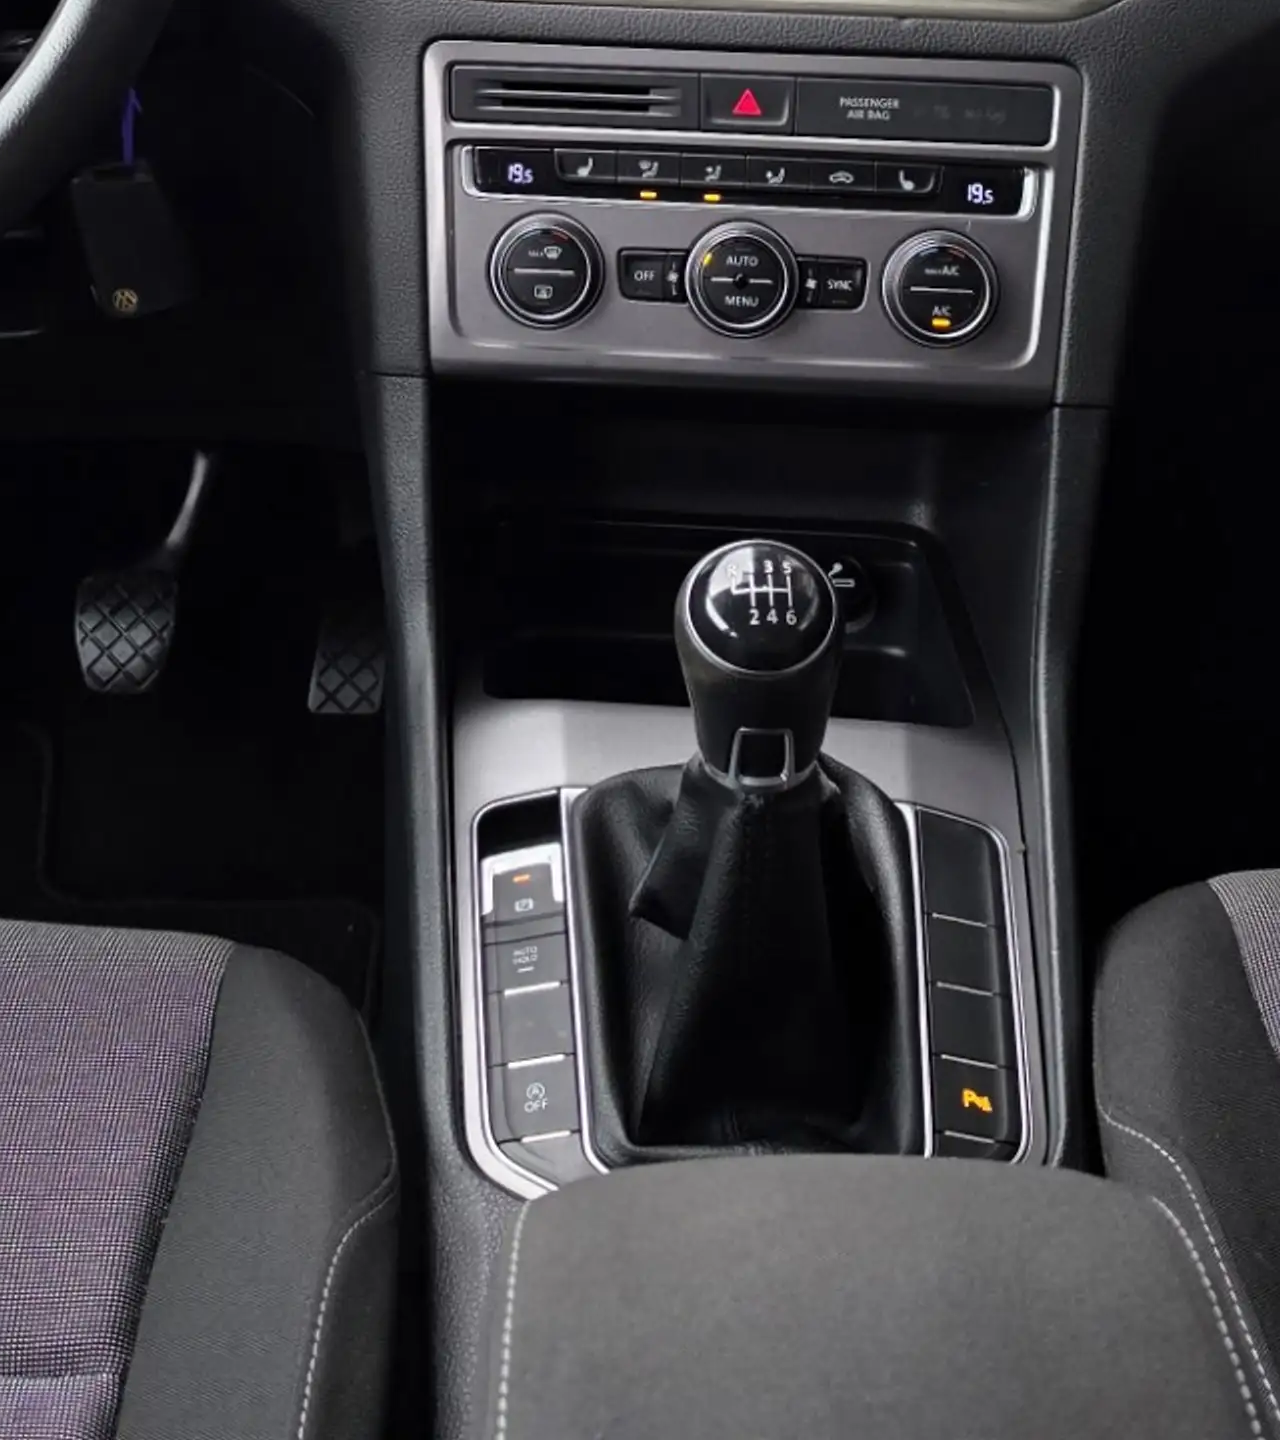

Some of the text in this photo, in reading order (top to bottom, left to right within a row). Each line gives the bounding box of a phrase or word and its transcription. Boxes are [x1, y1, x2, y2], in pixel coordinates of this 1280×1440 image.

[839, 96, 900, 110] PASSENGER
[846, 110, 891, 121] AIR BAG
[726, 255, 759, 268] AUTO
[634, 270, 656, 282] OFF
[827, 279, 853, 292] SYNC
[724, 295, 759, 307] MENU
[763, 560, 774, 574] 3
[782, 560, 792, 574] 5
[749, 608, 797, 626] 2 4 6
[524, 1099, 549, 1113] OFF
